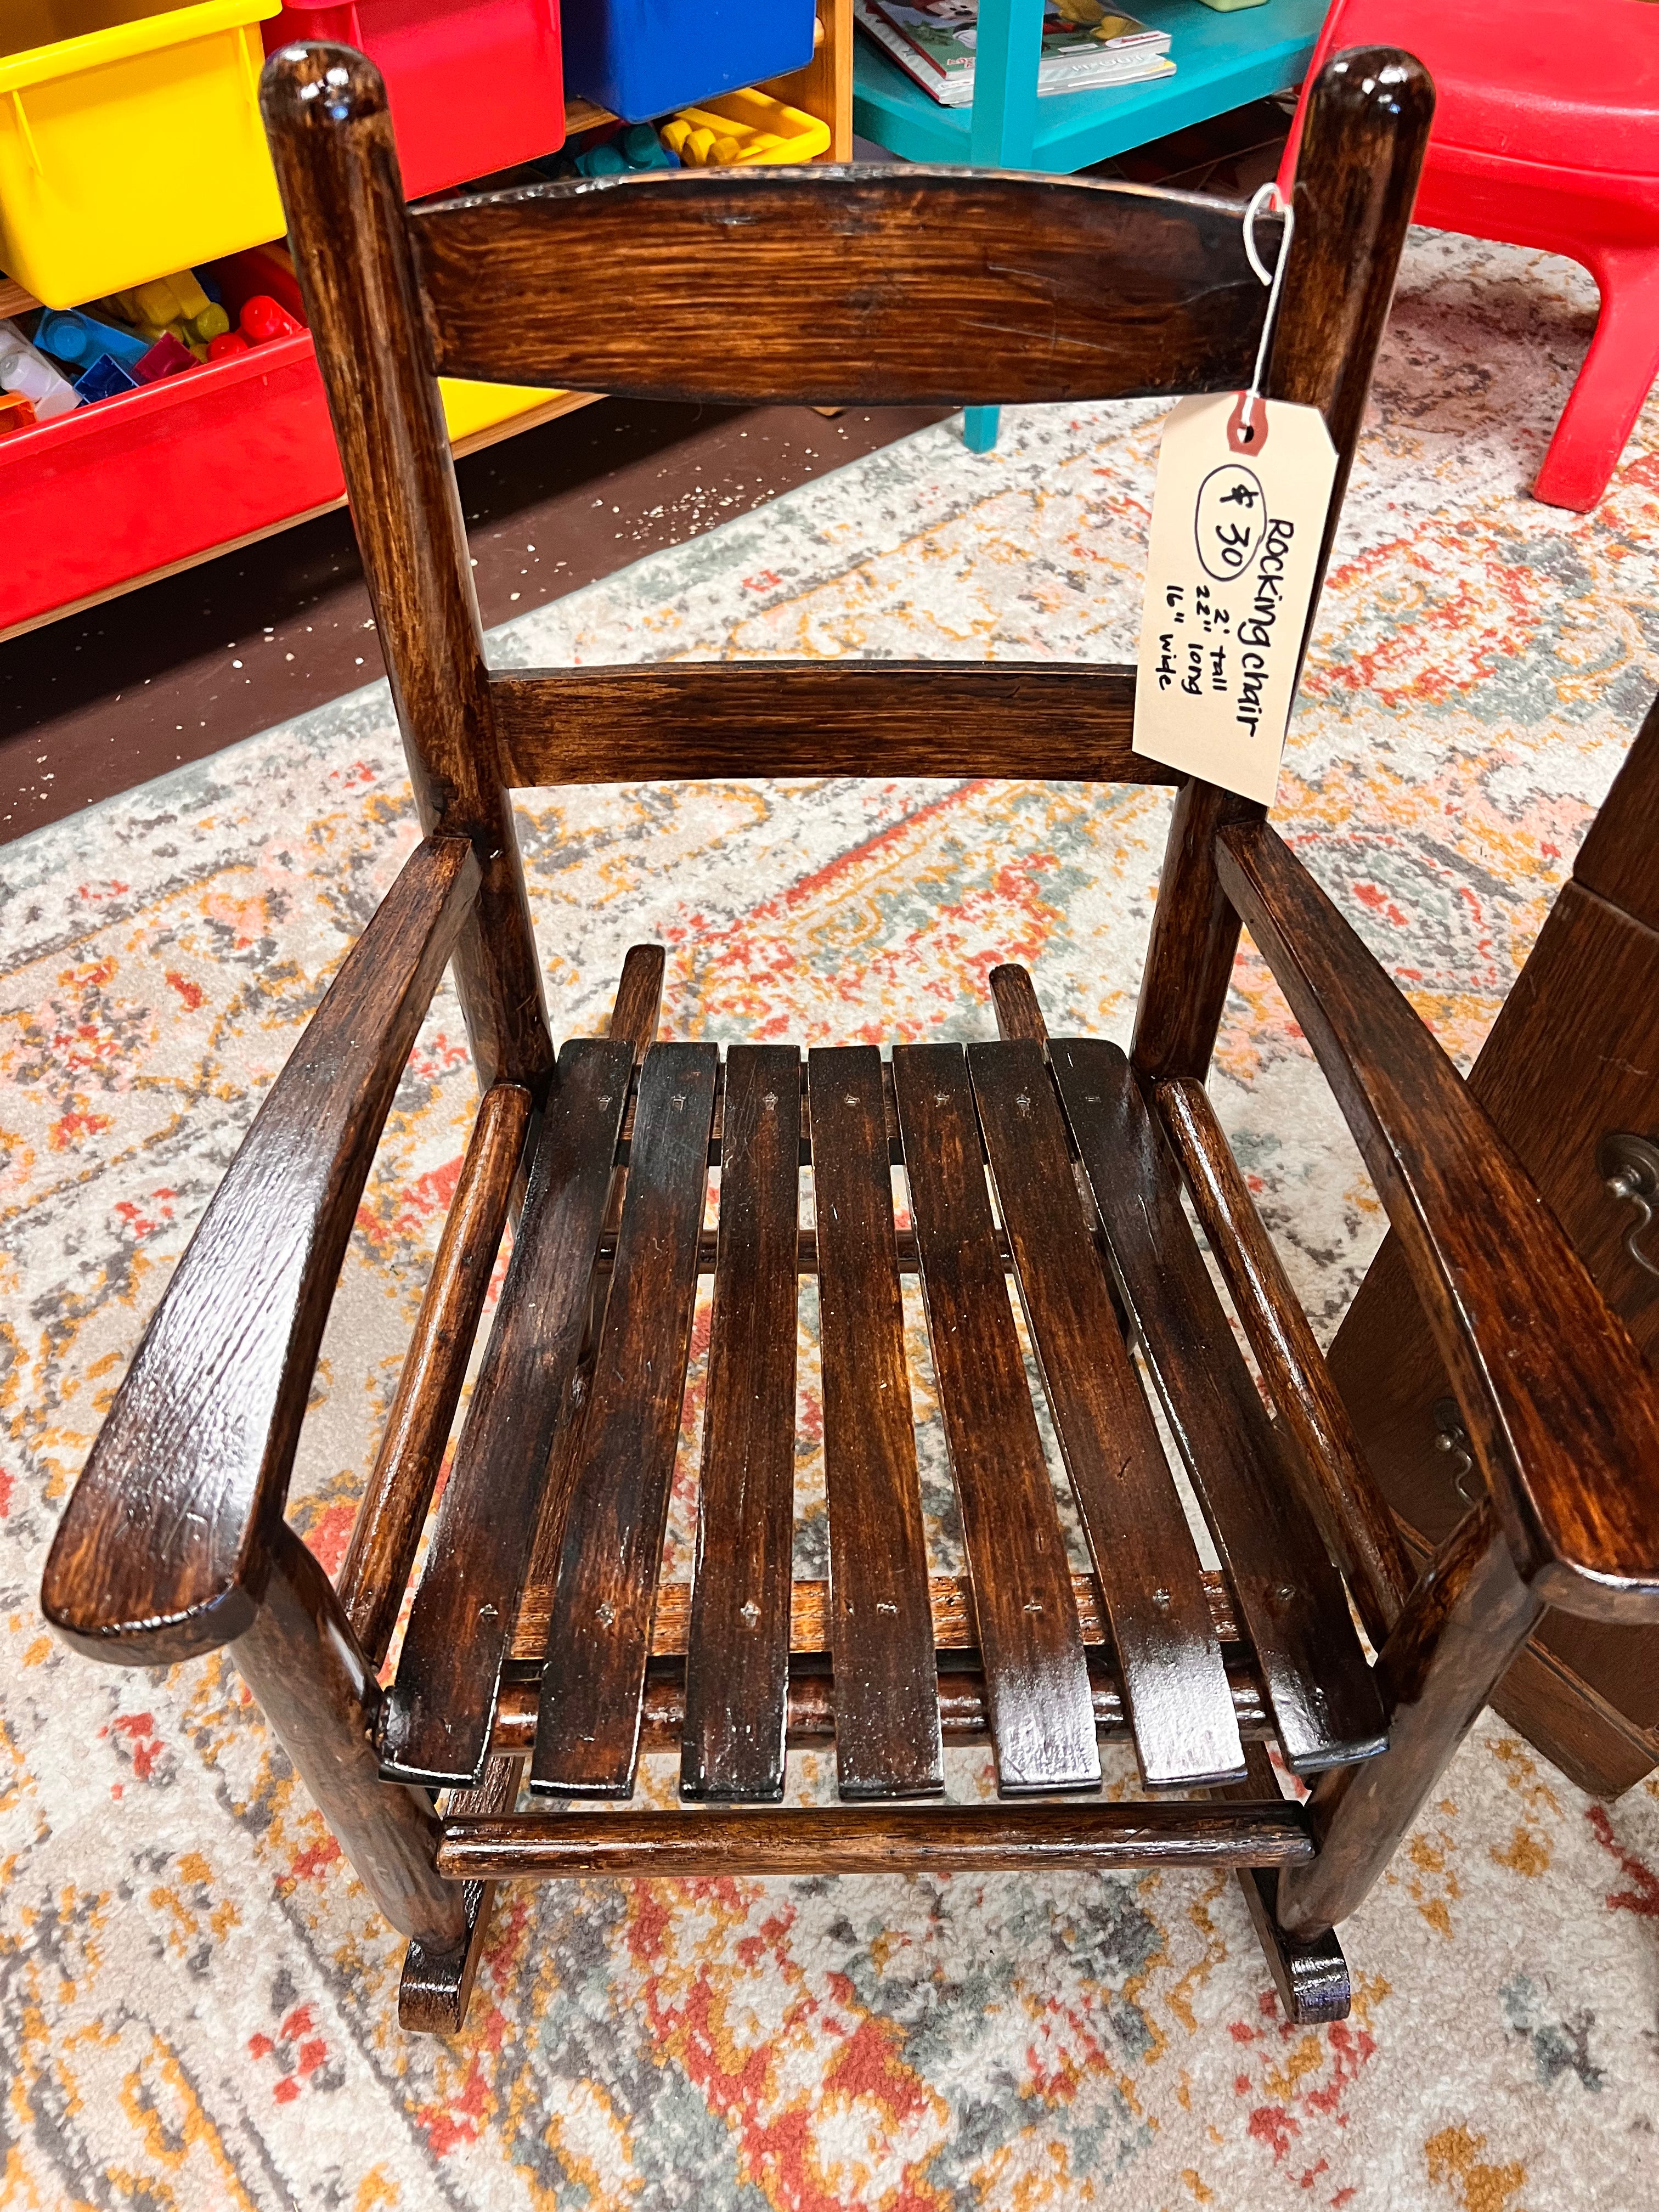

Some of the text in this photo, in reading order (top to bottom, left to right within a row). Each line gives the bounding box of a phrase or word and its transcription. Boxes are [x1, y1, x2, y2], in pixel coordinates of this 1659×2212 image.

[1155, 585, 1185, 691] 16" wide
[1181, 585, 1211, 696] 22" long
[1209, 645, 1228, 692] tall
[1236, 518, 1295, 737] Rocking chair
